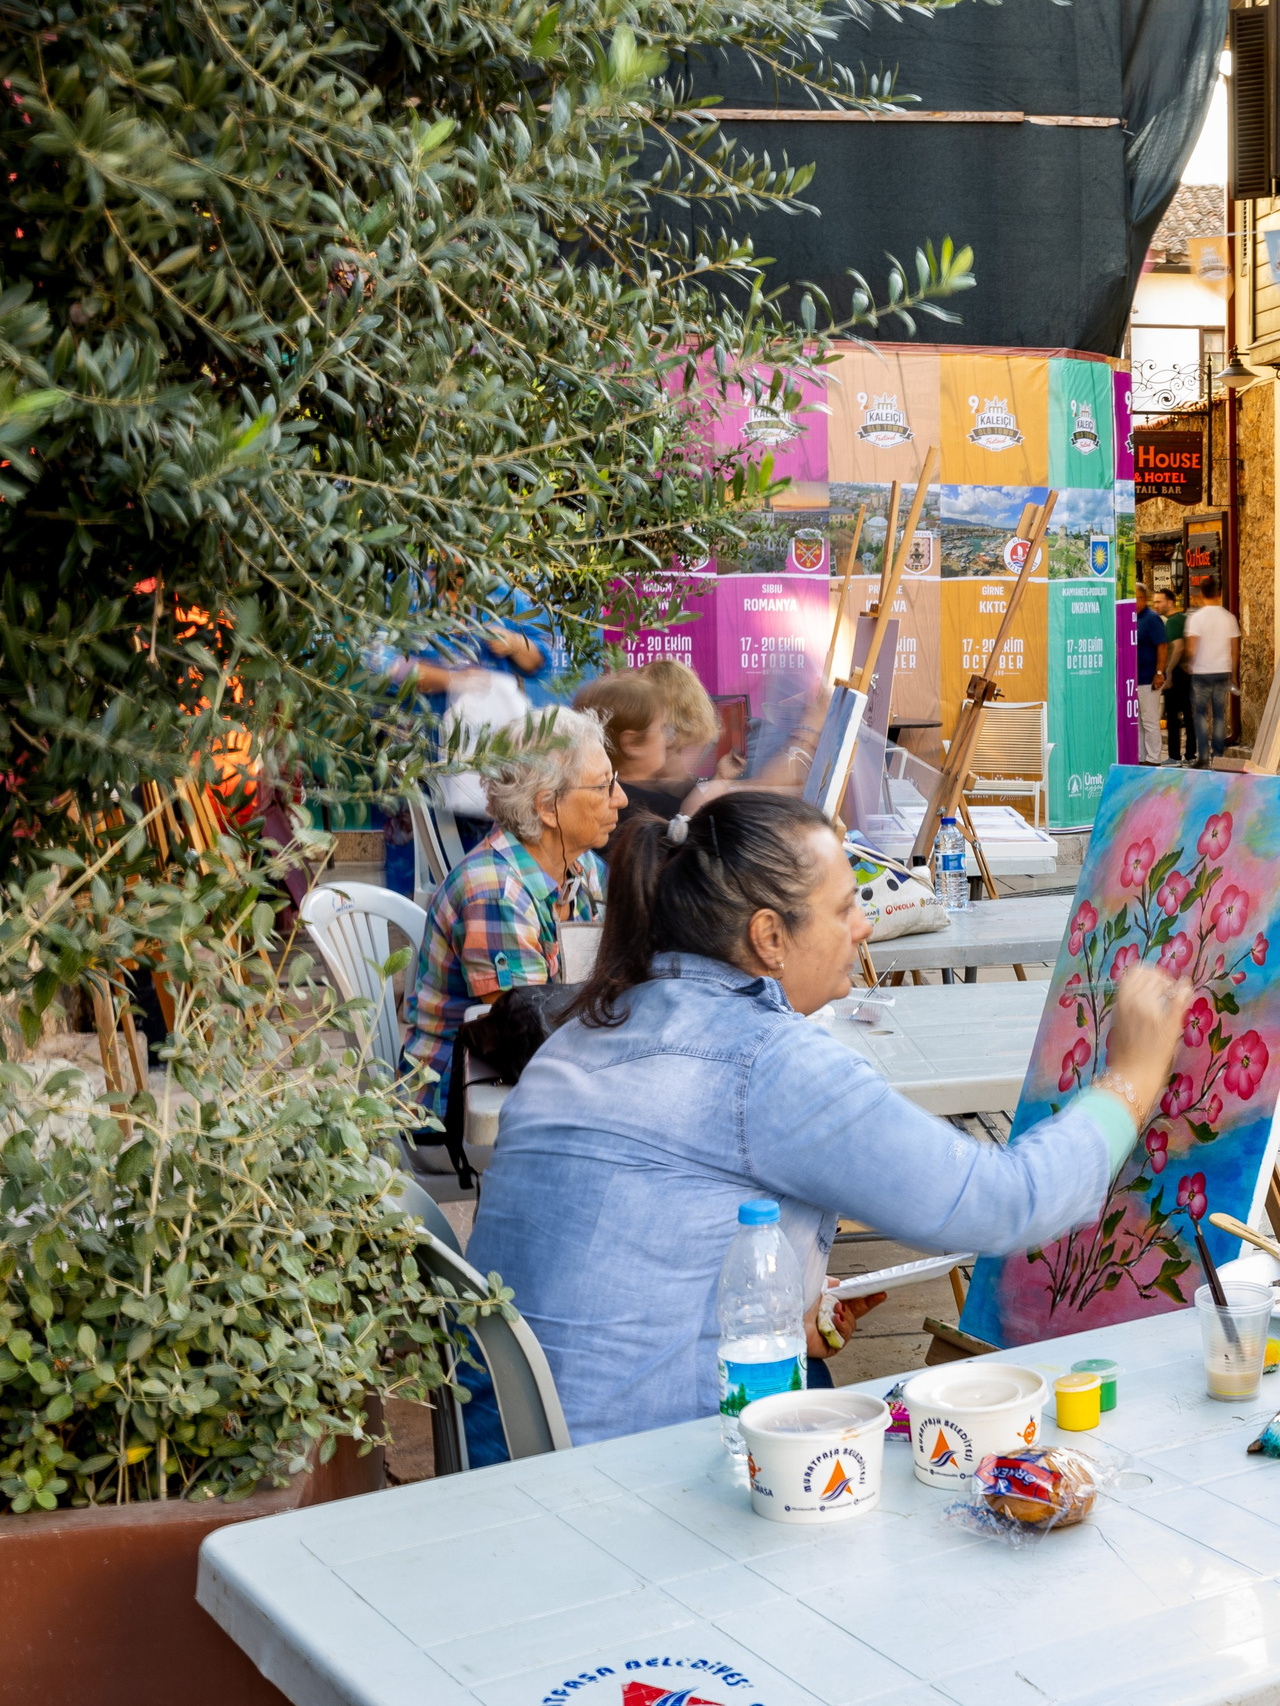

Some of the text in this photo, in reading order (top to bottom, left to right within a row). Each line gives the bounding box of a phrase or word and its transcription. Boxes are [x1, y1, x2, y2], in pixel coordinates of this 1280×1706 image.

[1134, 472, 1187, 483] & HOTEL
[1162, 486, 1182, 494] BAR
[762, 584, 783, 593] SIBIU
[982, 585, 1004, 595] GİRNE
[744, 598, 798, 611] ROMANYA
[979, 601, 1007, 613] KKTC
[1071, 602, 1100, 614] UKRAYNA
[648, 636, 661, 651] 20
[741, 637, 752, 651] 17
[761, 637, 775, 651] 20
[962, 638, 973, 653] 17
[1067, 640, 1073, 653] 17
[1079, 639, 1087, 652] 20
[741, 653, 804, 668] OCTOBER
[963, 654, 1023, 669] OCTBER
[1067, 654, 1103, 669] OCTOBER
[1126, 679, 1135, 696] 17
[1084, 772, 1102, 786] Ümit
[893, 902, 916, 912] VEOLIA
